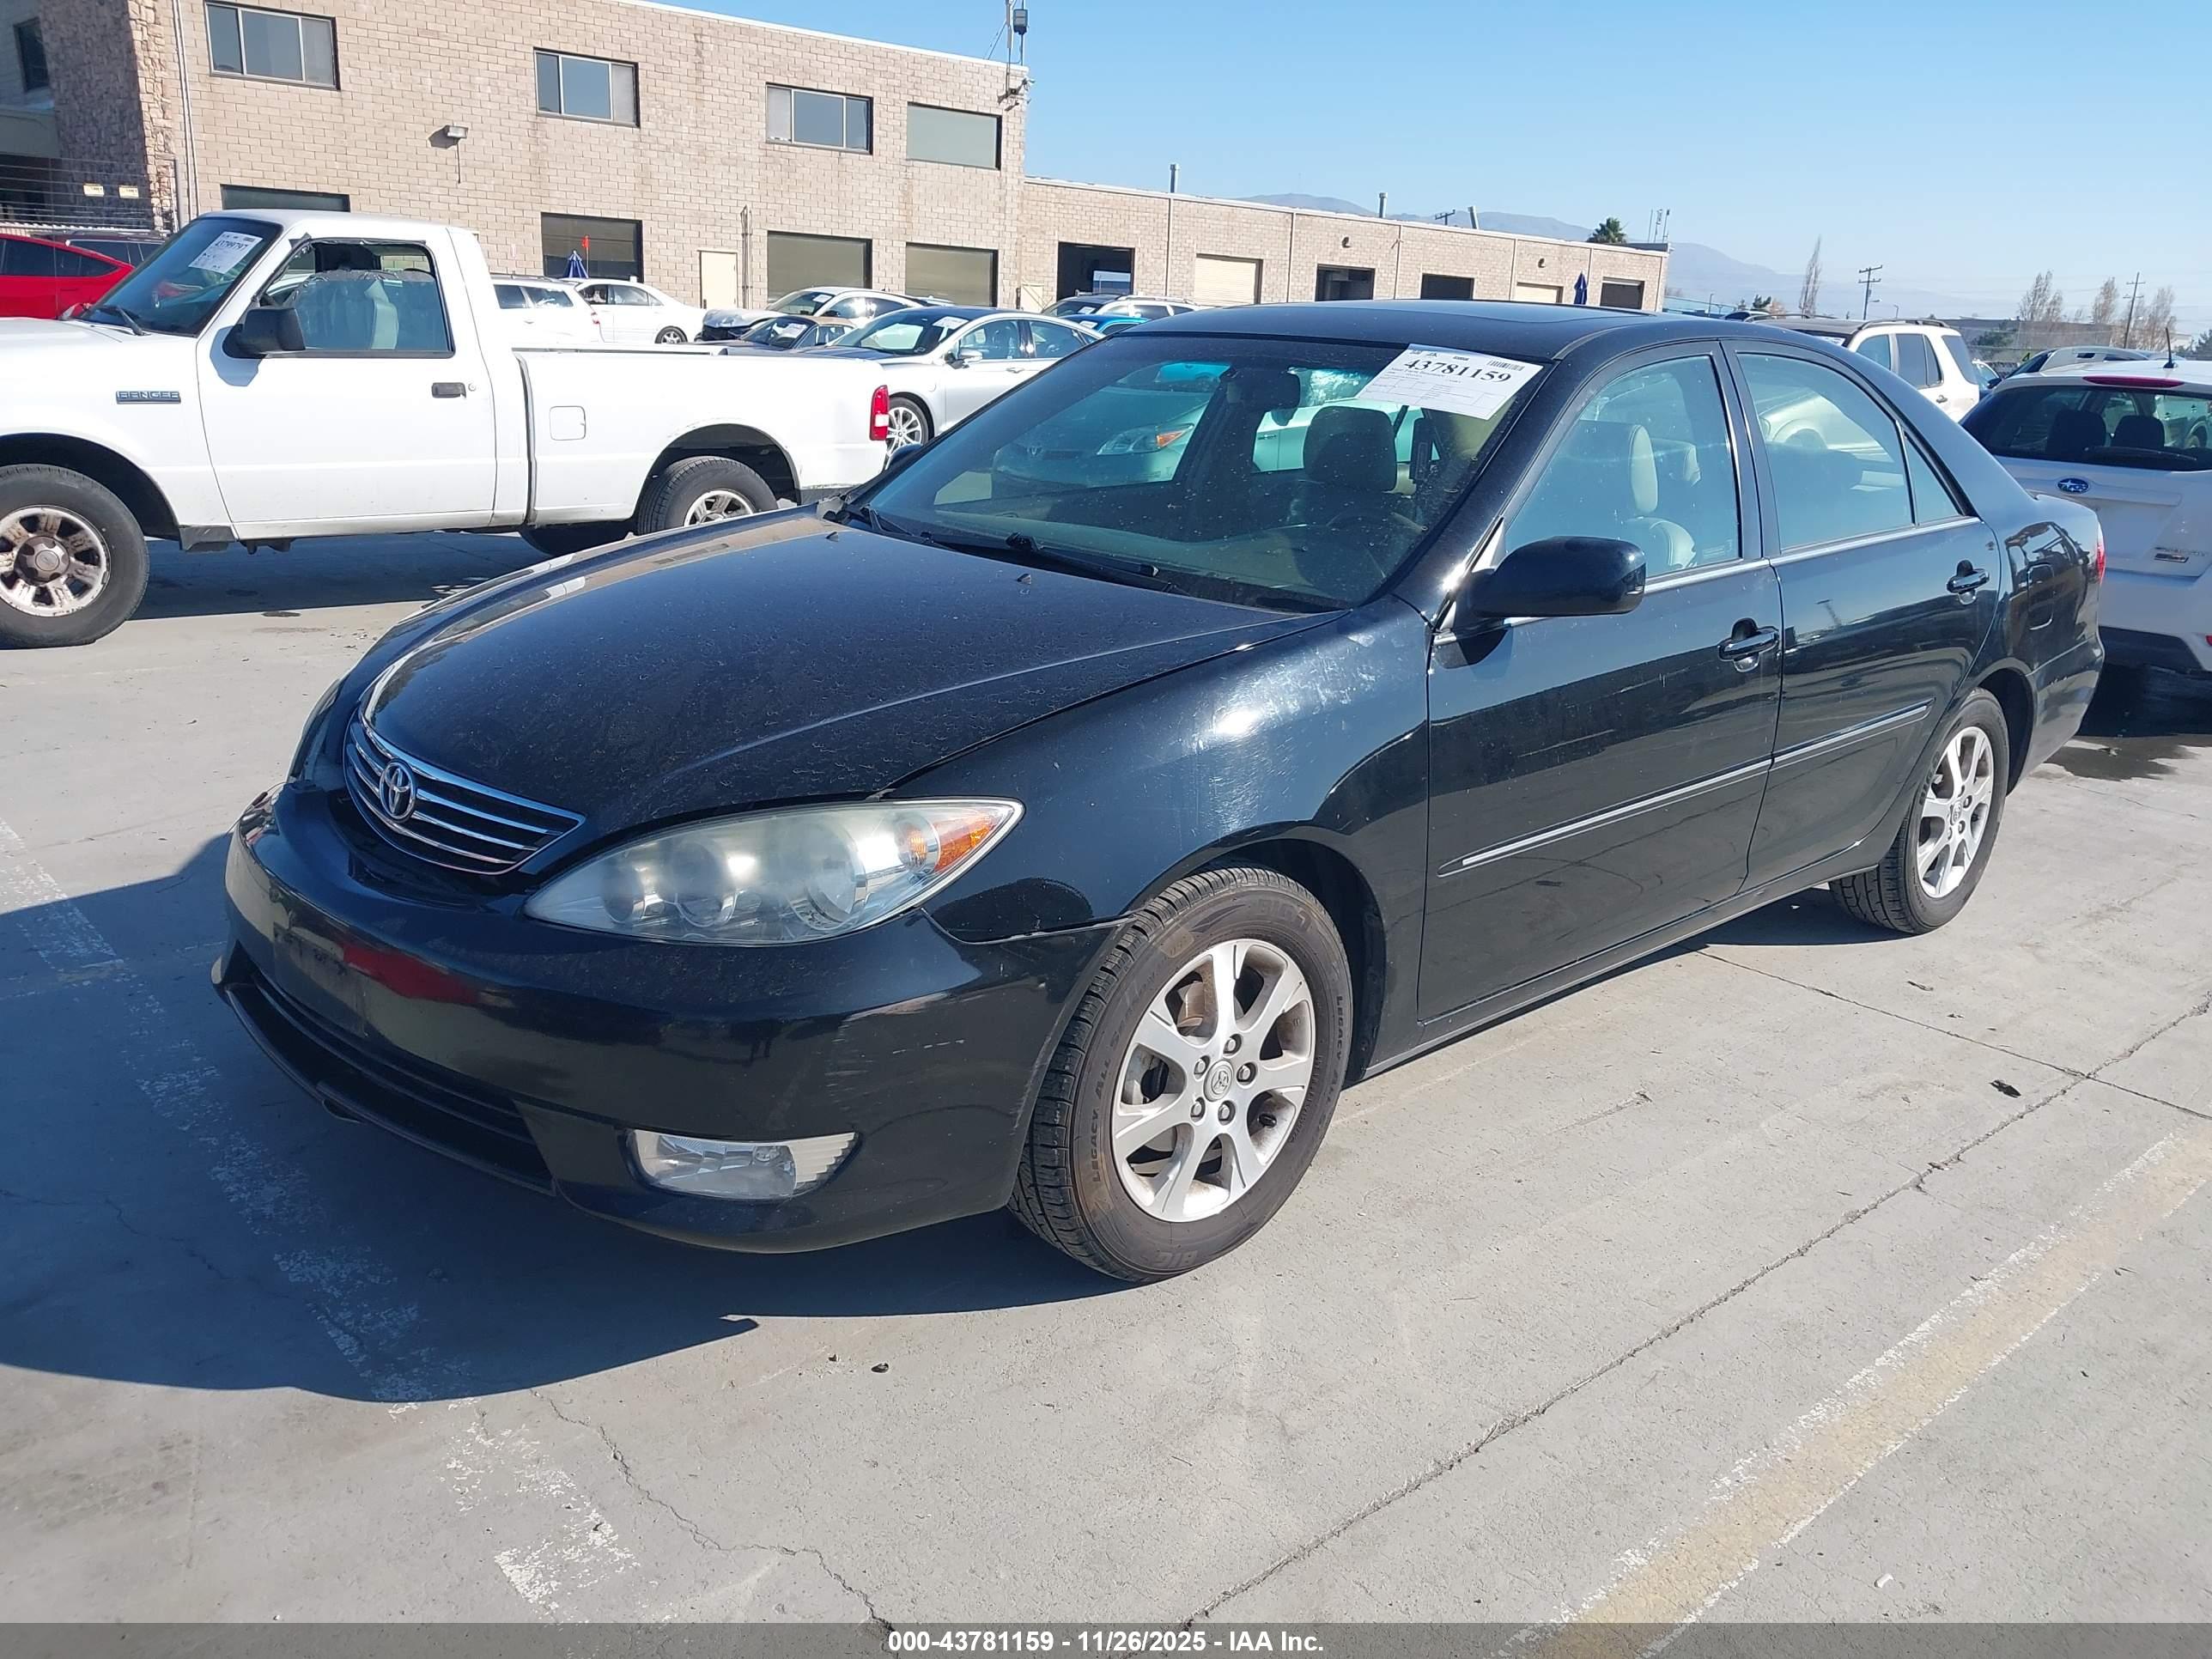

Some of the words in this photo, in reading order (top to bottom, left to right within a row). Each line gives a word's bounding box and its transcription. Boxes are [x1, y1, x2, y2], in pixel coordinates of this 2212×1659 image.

[1404, 359, 1512, 383] 43781159
[1335, 995, 1345, 1060] LEGACY
[1091, 1109, 1101, 1182] LEGACY
